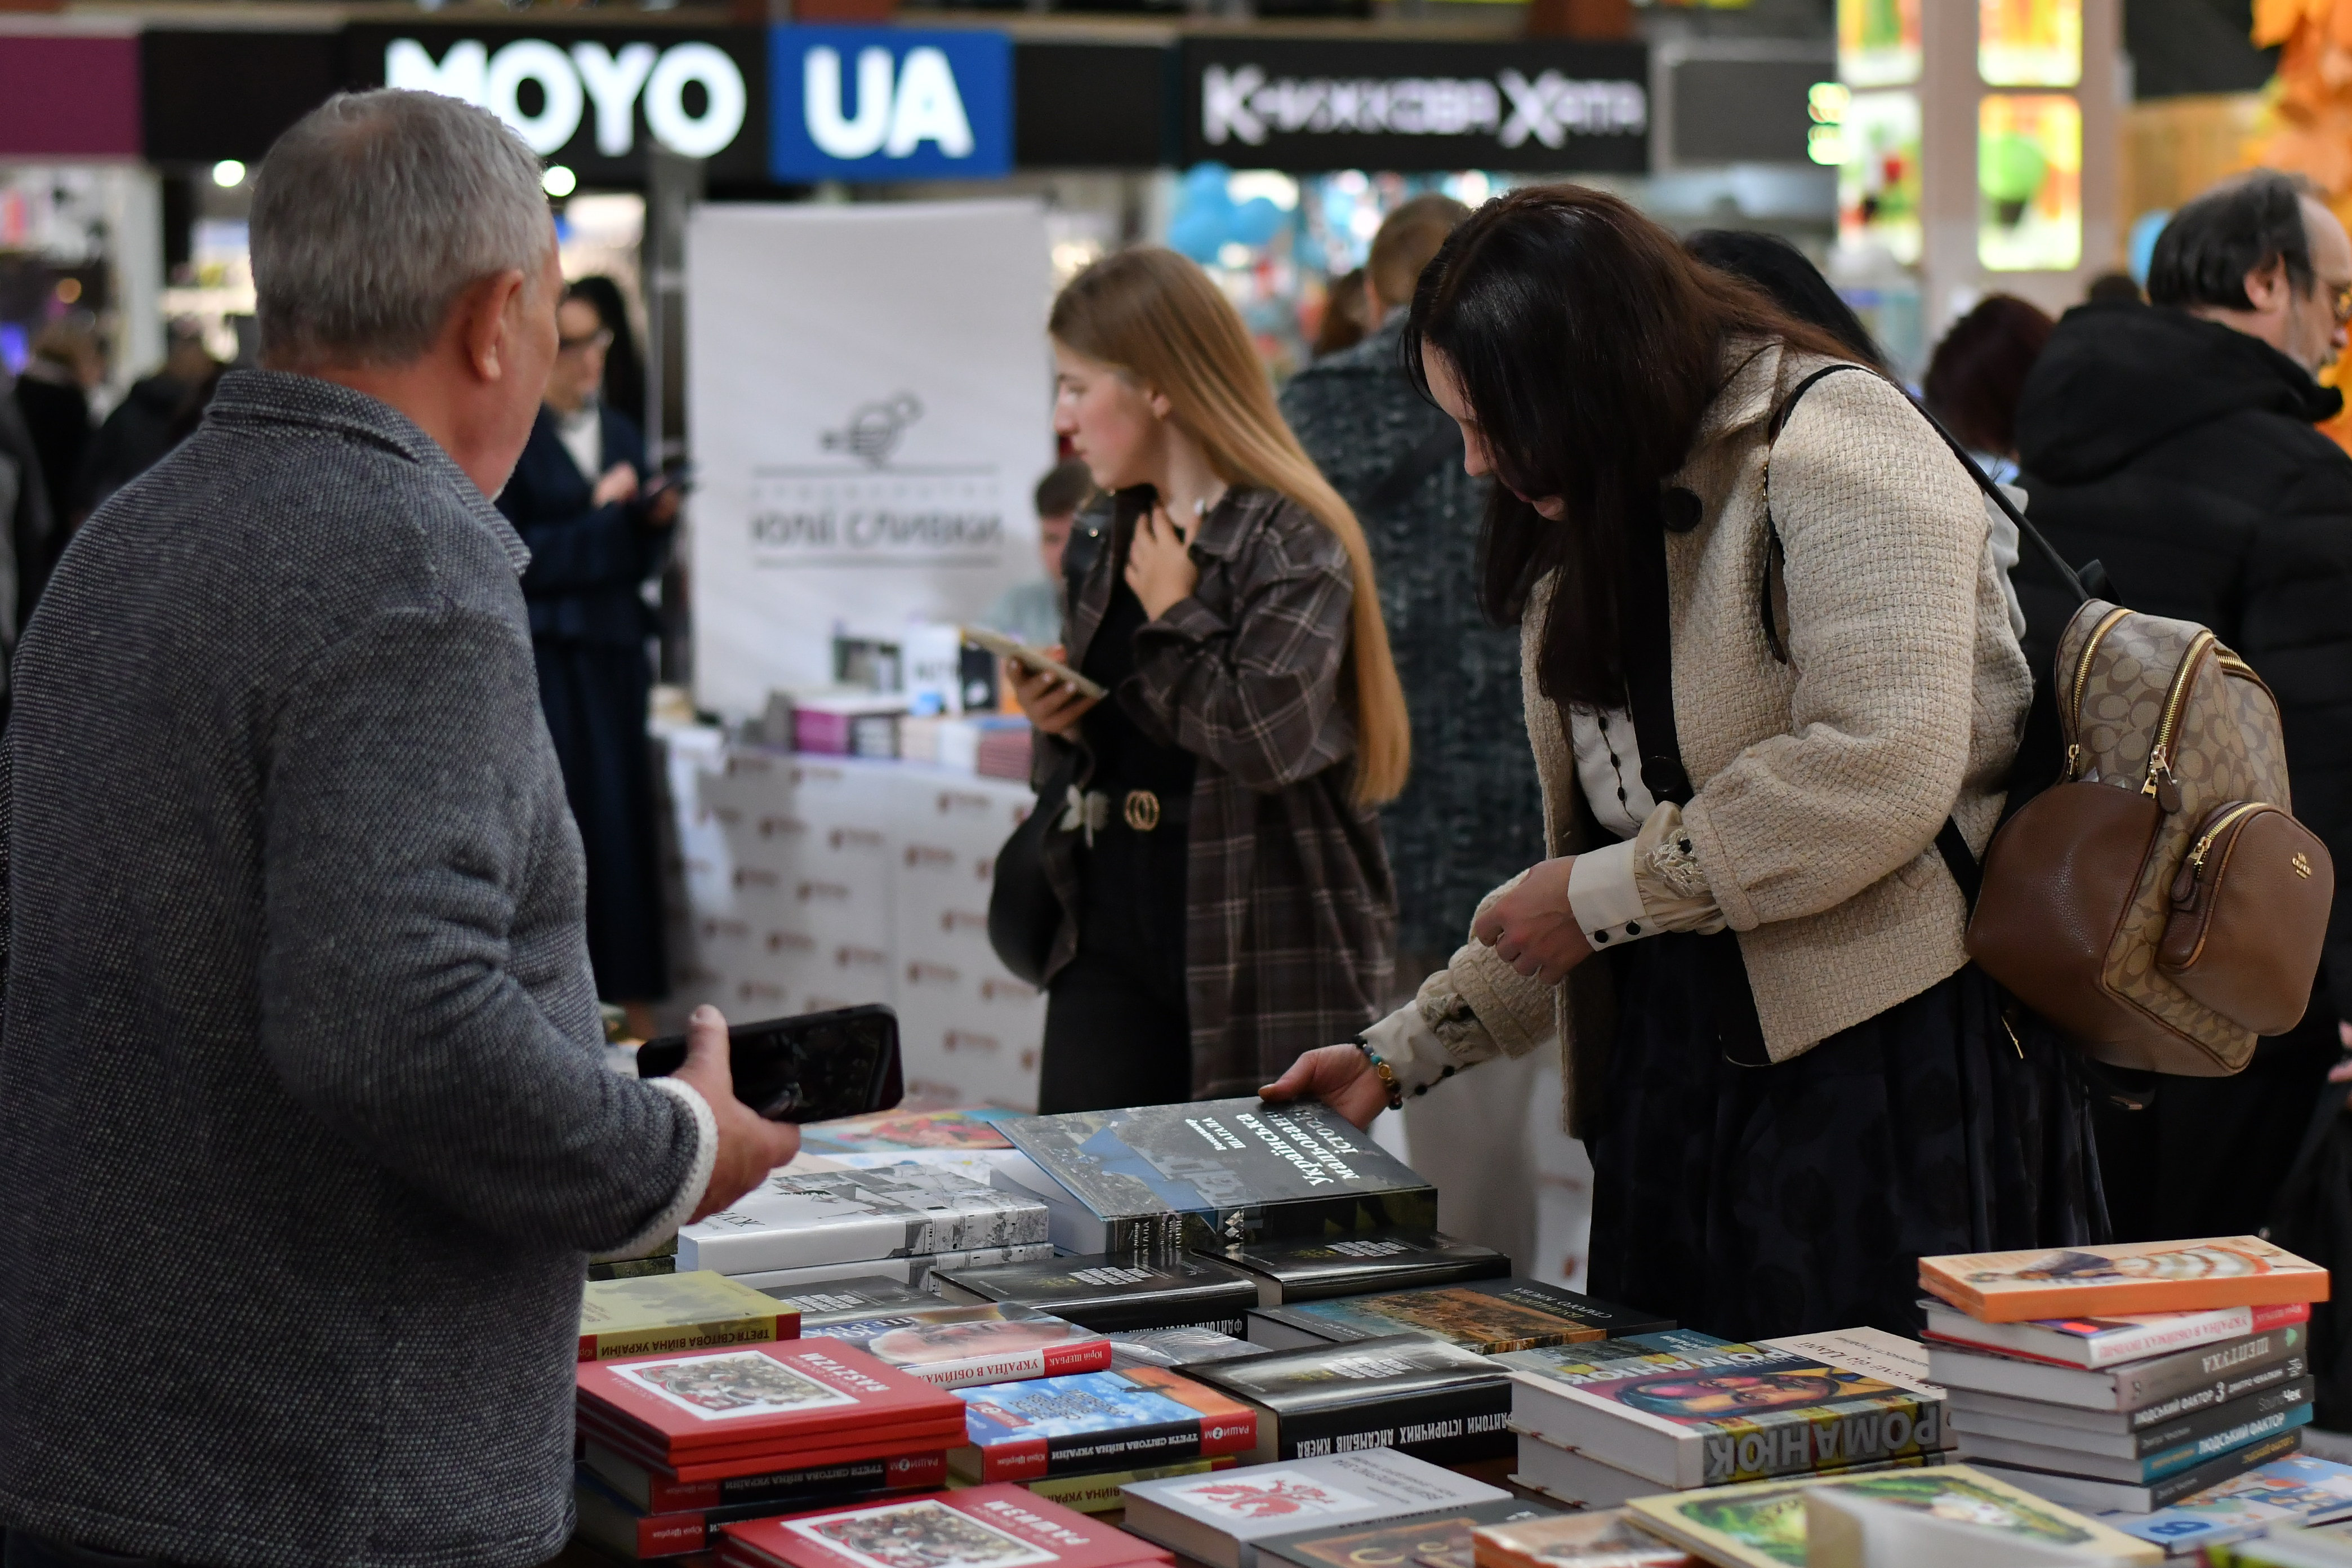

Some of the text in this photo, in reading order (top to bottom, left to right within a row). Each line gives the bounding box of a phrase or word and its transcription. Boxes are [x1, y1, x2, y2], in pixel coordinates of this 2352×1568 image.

[802, 45, 975, 160] UA
[1236, 1112, 1334, 1187] Українська
[602, 1329, 770, 1357] ТРЕТЯ СВІТОВА ВІЙНА УКРАЇНИ
[986, 1358, 1040, 1375] УКРАЇНА
[1049, 1349, 1103, 1366] Юрій ЩЕРБАК
[1557, 1348, 1795, 1386] РОМАНЮК
[976, 1367, 984, 1377] В
[2215, 1381, 2225, 1403] 3
[1337, 1428, 1394, 1453] АНСАМБЛІВ
[1399, 1419, 1462, 1445] ІСТОРИЧНИХ
[1708, 1405, 1937, 1477] РОМАНЮК
[1052, 1432, 1199, 1462] ТРЕТЯ СВІТОВА ВІЙНА УКРАЇНИ
[1297, 1437, 1331, 1459] КИЄВА
